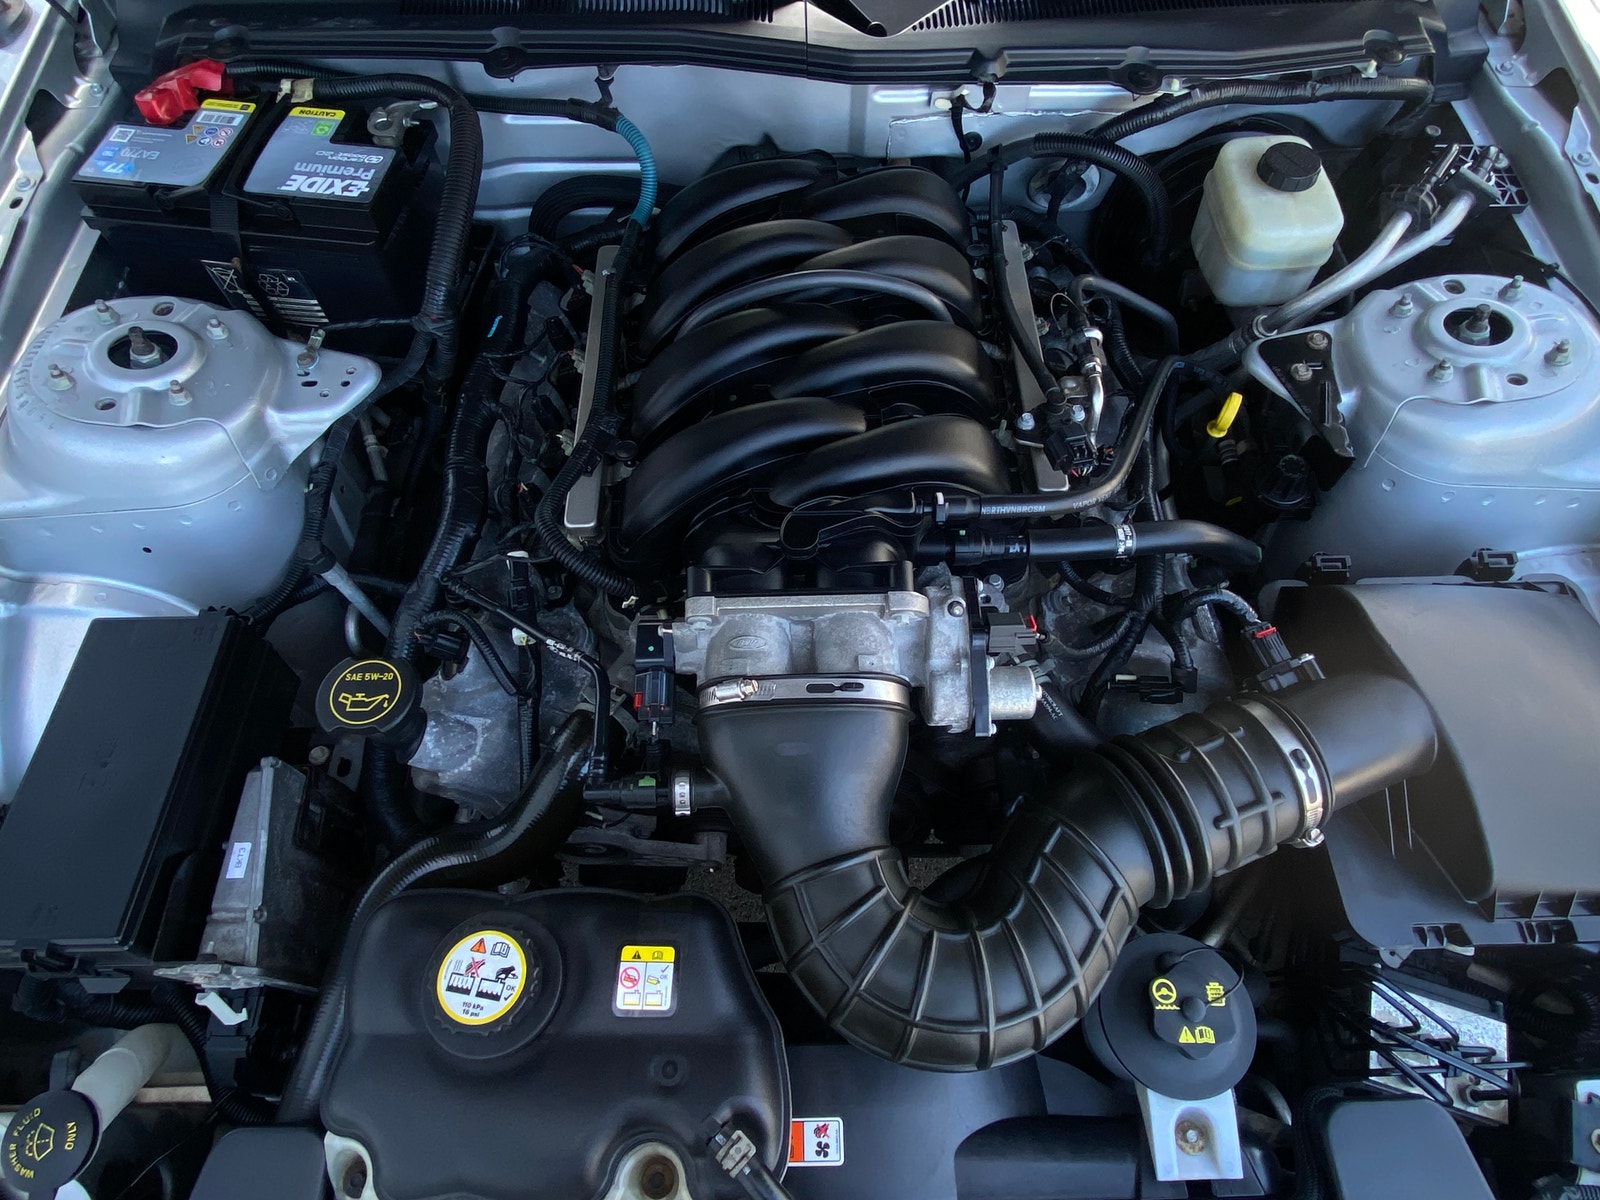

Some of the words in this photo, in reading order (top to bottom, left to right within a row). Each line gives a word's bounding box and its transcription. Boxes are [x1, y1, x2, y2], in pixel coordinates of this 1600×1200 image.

[299, 109, 336, 118] CAUTION
[328, 155, 364, 163] carbon
[335, 152, 367, 160] boost
[293, 161, 376, 180] Premium
[279, 174, 370, 197] EXIDE
[1073, 497, 1096, 509] VAPOR
[345, 672, 363, 681] SAE
[364, 672, 394, 681] 5W-20
[505, 984, 516, 992] OK
[462, 1001, 471, 1009] 110
[472, 1003, 484, 1011] kPa
[13, 1107, 41, 1137] FLUID
[64, 1121, 77, 1150] ONLY
[9, 1143, 35, 1179] WASHER
